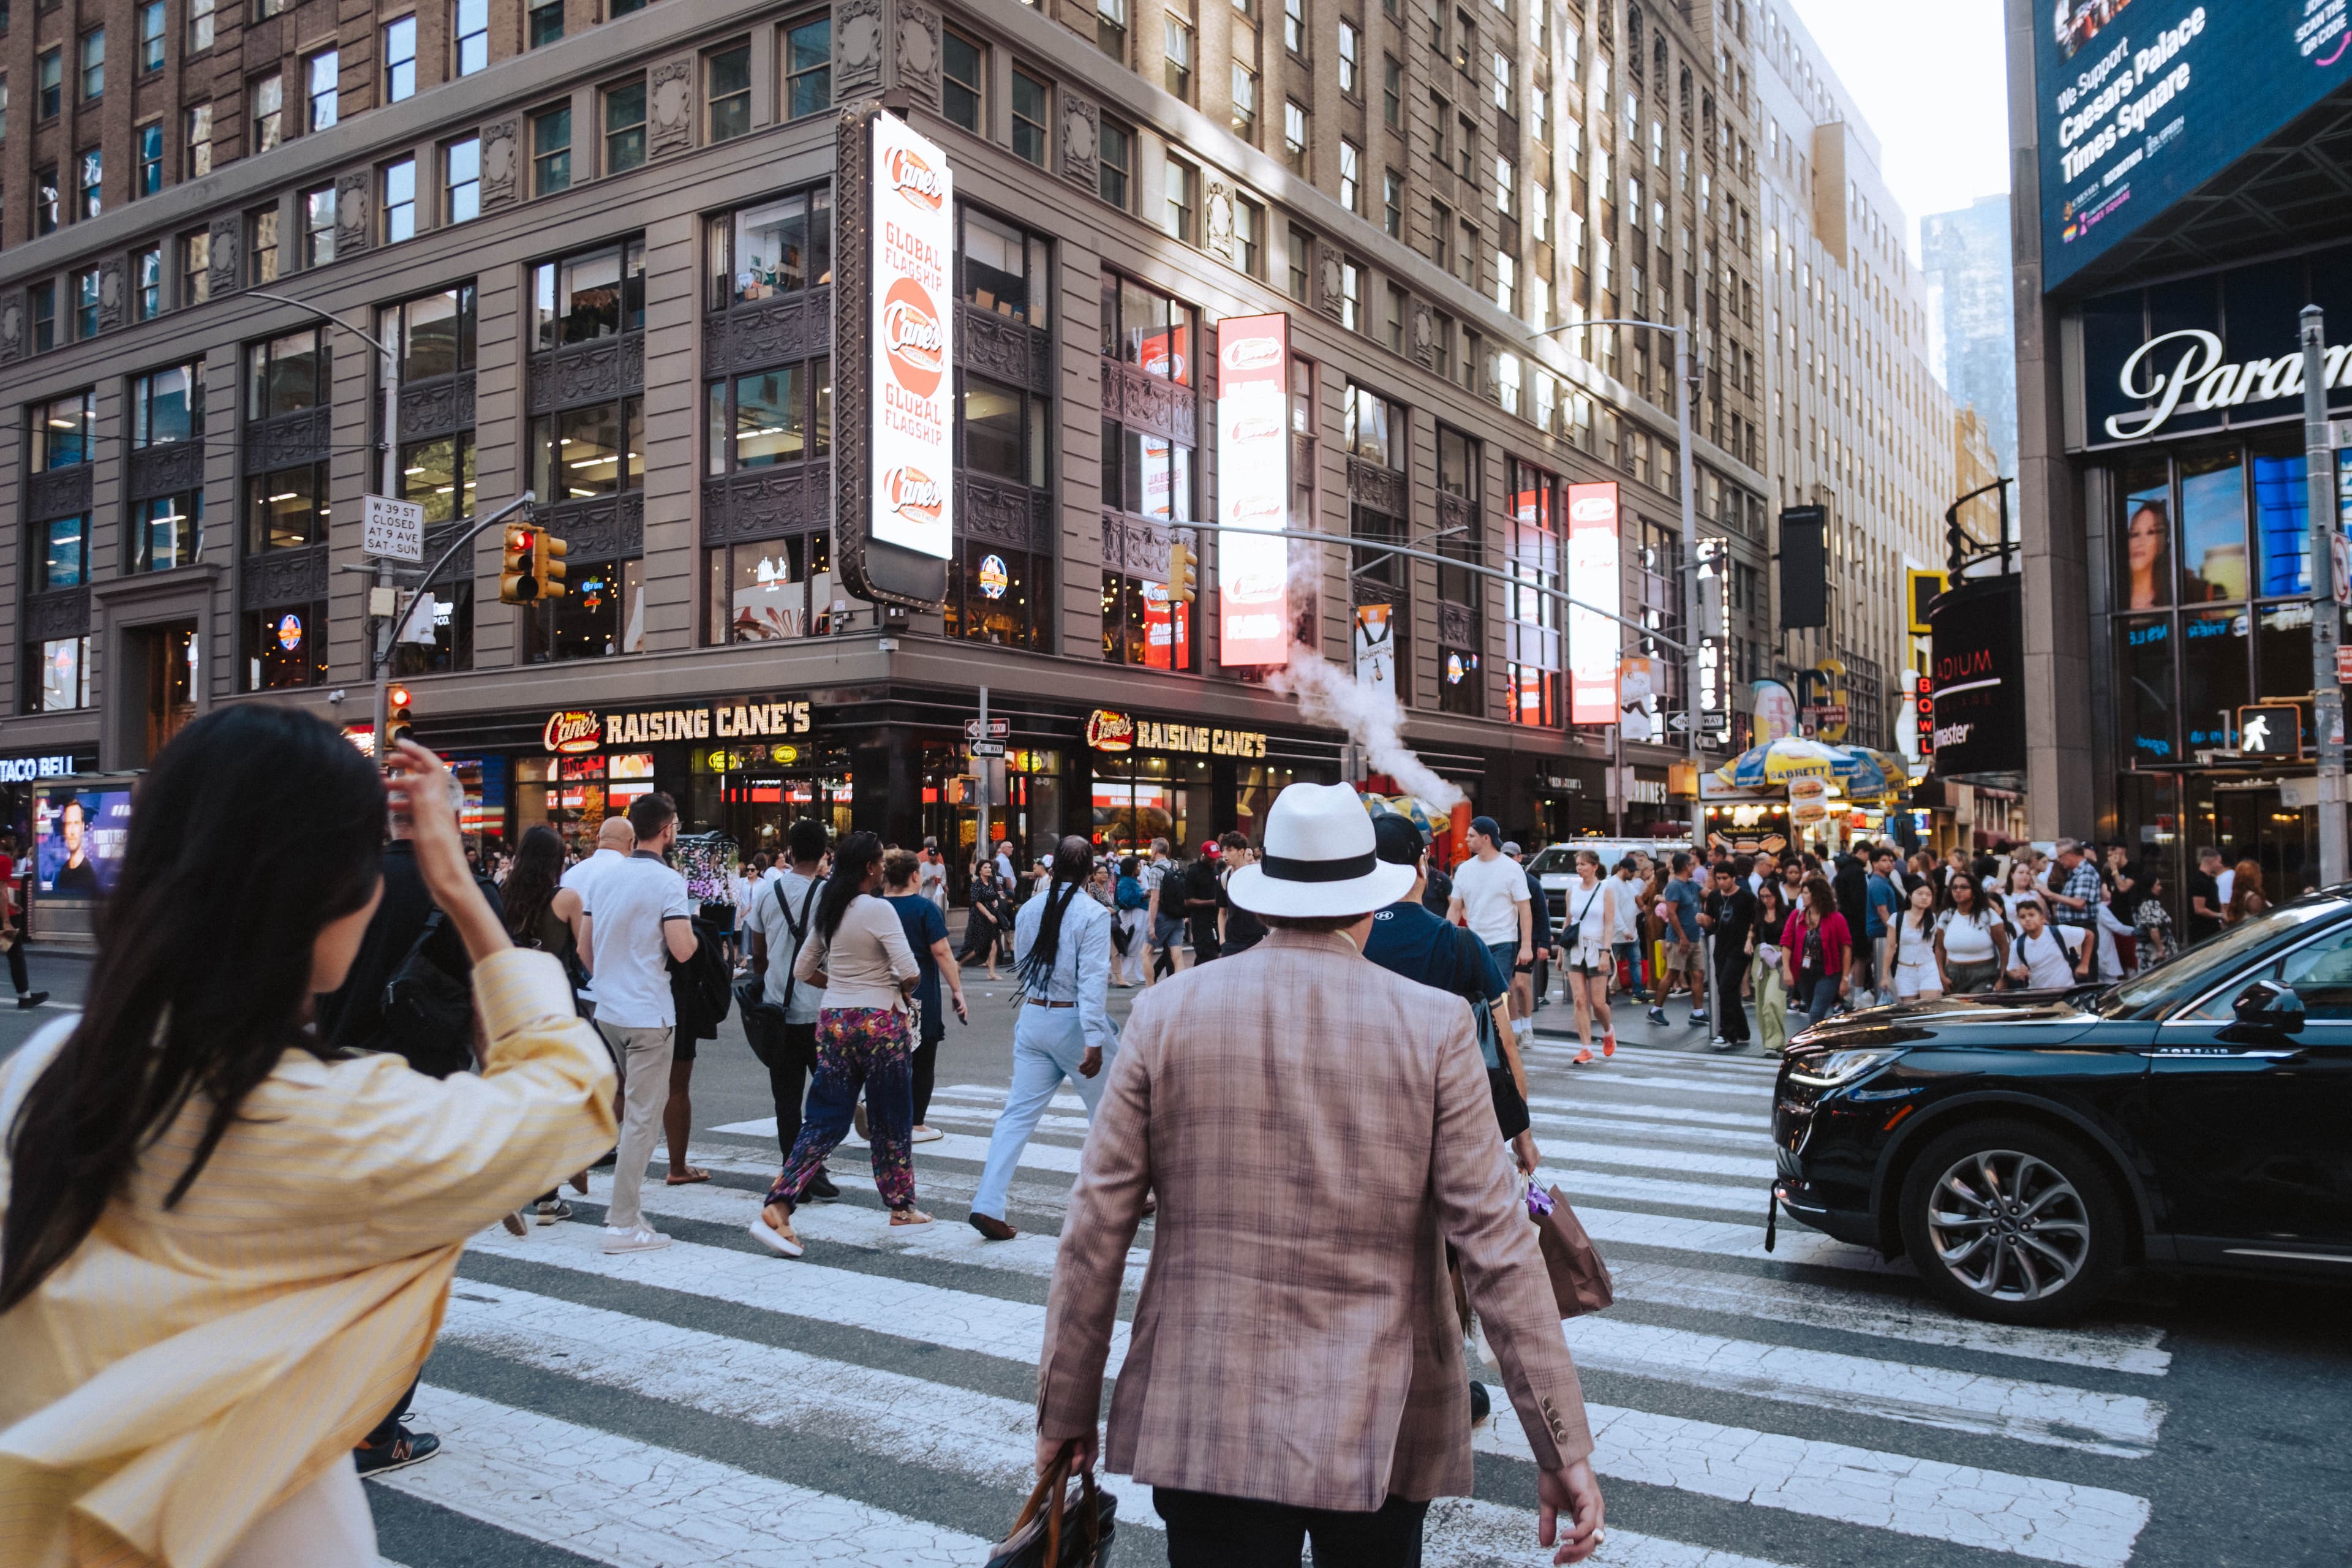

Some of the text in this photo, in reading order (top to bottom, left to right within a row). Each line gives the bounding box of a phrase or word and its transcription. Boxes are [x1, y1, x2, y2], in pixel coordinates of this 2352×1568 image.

[2294, 10, 2325, 43] SCAN
[2318, 13, 2347, 45] CODE
[2057, 36, 2128, 115] We Support
[2059, 7, 2206, 148] Caesars Palace
[2060, 124, 2117, 184] Times
[2117, 62, 2190, 138] Square
[886, 221, 941, 272] GLOBAL
[886, 247, 942, 292] FLAGSHIP
[885, 300, 943, 352] Cane's
[886, 382, 941, 426] GLOBAL
[886, 409, 942, 446] FLAGSHIP
[886, 466, 942, 513] Cane's
[373, 514, 415, 530] CLOSED
[374, 502, 415, 518] W 39 ST
[368, 539, 387, 549] SAT
[397, 544, 418, 555] SUN
[369, 527, 382, 537] AT
[397, 533, 418, 543] AVE
[1359, 645, 1392, 662] MORMON
[1936, 649, 1992, 682] ADIUM
[544, 701, 811, 751] Cane's RAISING CANE'S
[1087, 709, 1267, 758] Cane's RAISING CANE'S
[1918, 677, 1932, 753] BOWL
[0, 756, 77, 782] TACO BELL
[777, 750, 794, 759] OPEN
[1770, 766, 1825, 780] SABRETT
